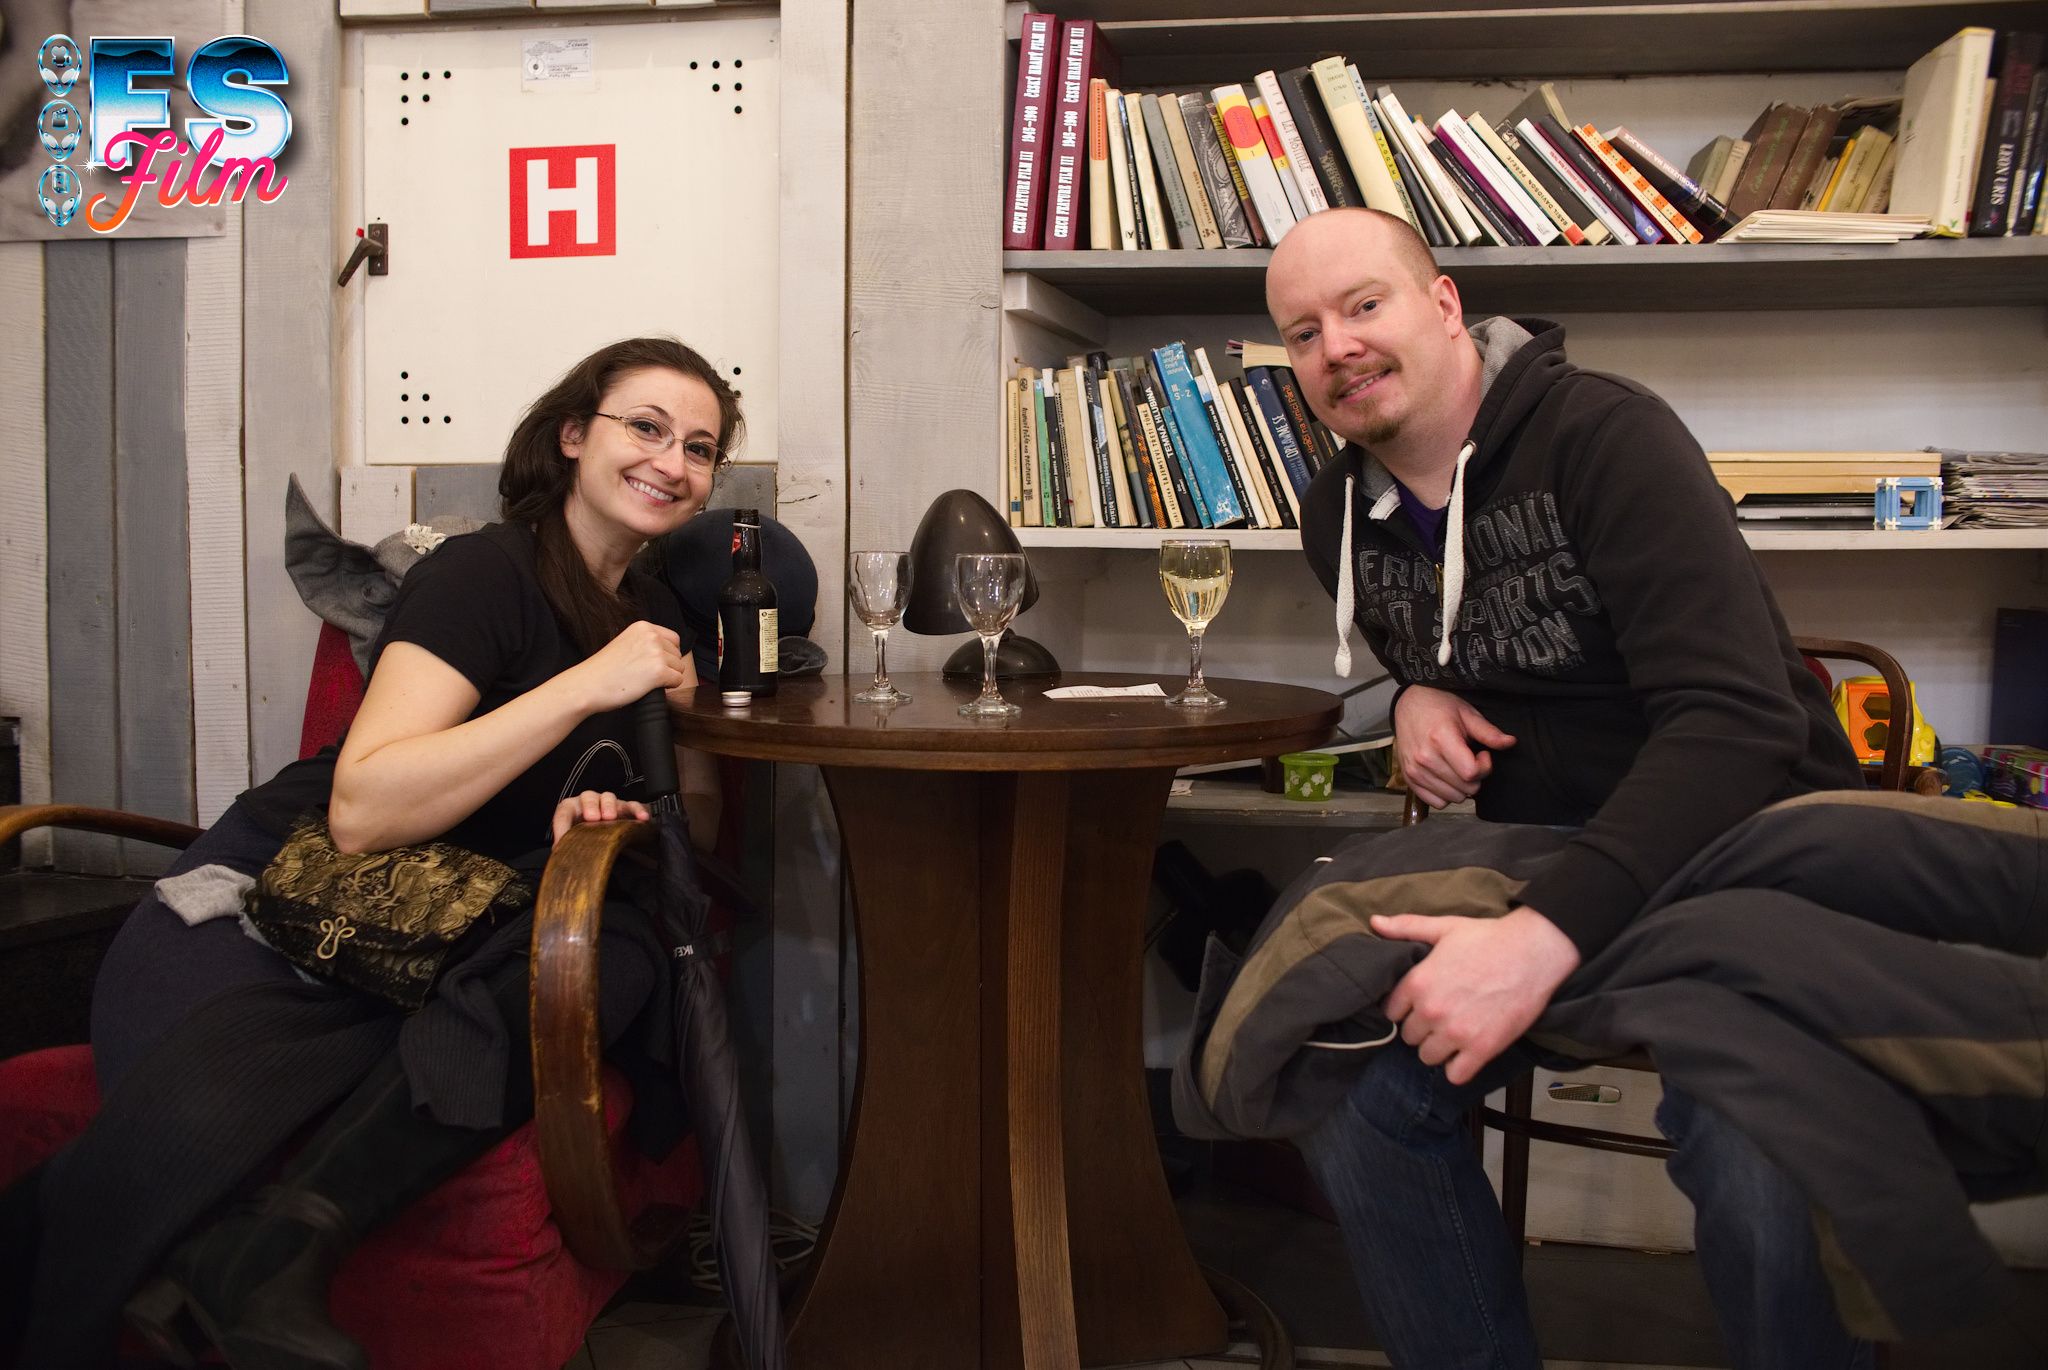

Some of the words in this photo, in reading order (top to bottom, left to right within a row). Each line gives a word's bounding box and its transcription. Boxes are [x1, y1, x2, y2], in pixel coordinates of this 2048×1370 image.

[1032, 21, 1047, 33] III
[1071, 27, 1085, 38] III
[1030, 32, 1046, 51] FILM
[1069, 38, 1084, 57] FILM
[1025, 75, 1043, 99] ČESKÝ
[1064, 80, 1082, 104] ČESKÝ
[1019, 150, 1034, 162] III
[1060, 155, 1074, 166] III
[1994, 142, 2015, 177] LEON
[1017, 161, 1033, 180] FILM
[1059, 166, 1074, 184] FILM
[526, 156, 599, 247] H
[1014, 179, 1031, 212] FEATURE
[1056, 184, 1072, 215] FEATURE
[1526, 178, 1555, 210] DAVIDSON
[1989, 176, 2009, 207] URIS
[1012, 211, 1028, 234] CZECH
[1054, 215, 1070, 238] CZECH
[1551, 207, 1570, 227] BASIL
[1143, 385, 1163, 424] HLUBINA
[1289, 401, 1304, 423] vinici
[1298, 422, 1308, 434] na
[1155, 423, 1174, 459] TEMNÁ
[1153, 447, 1170, 485] TAJEMSTVÍ
[673, 943, 695, 959] IKE
